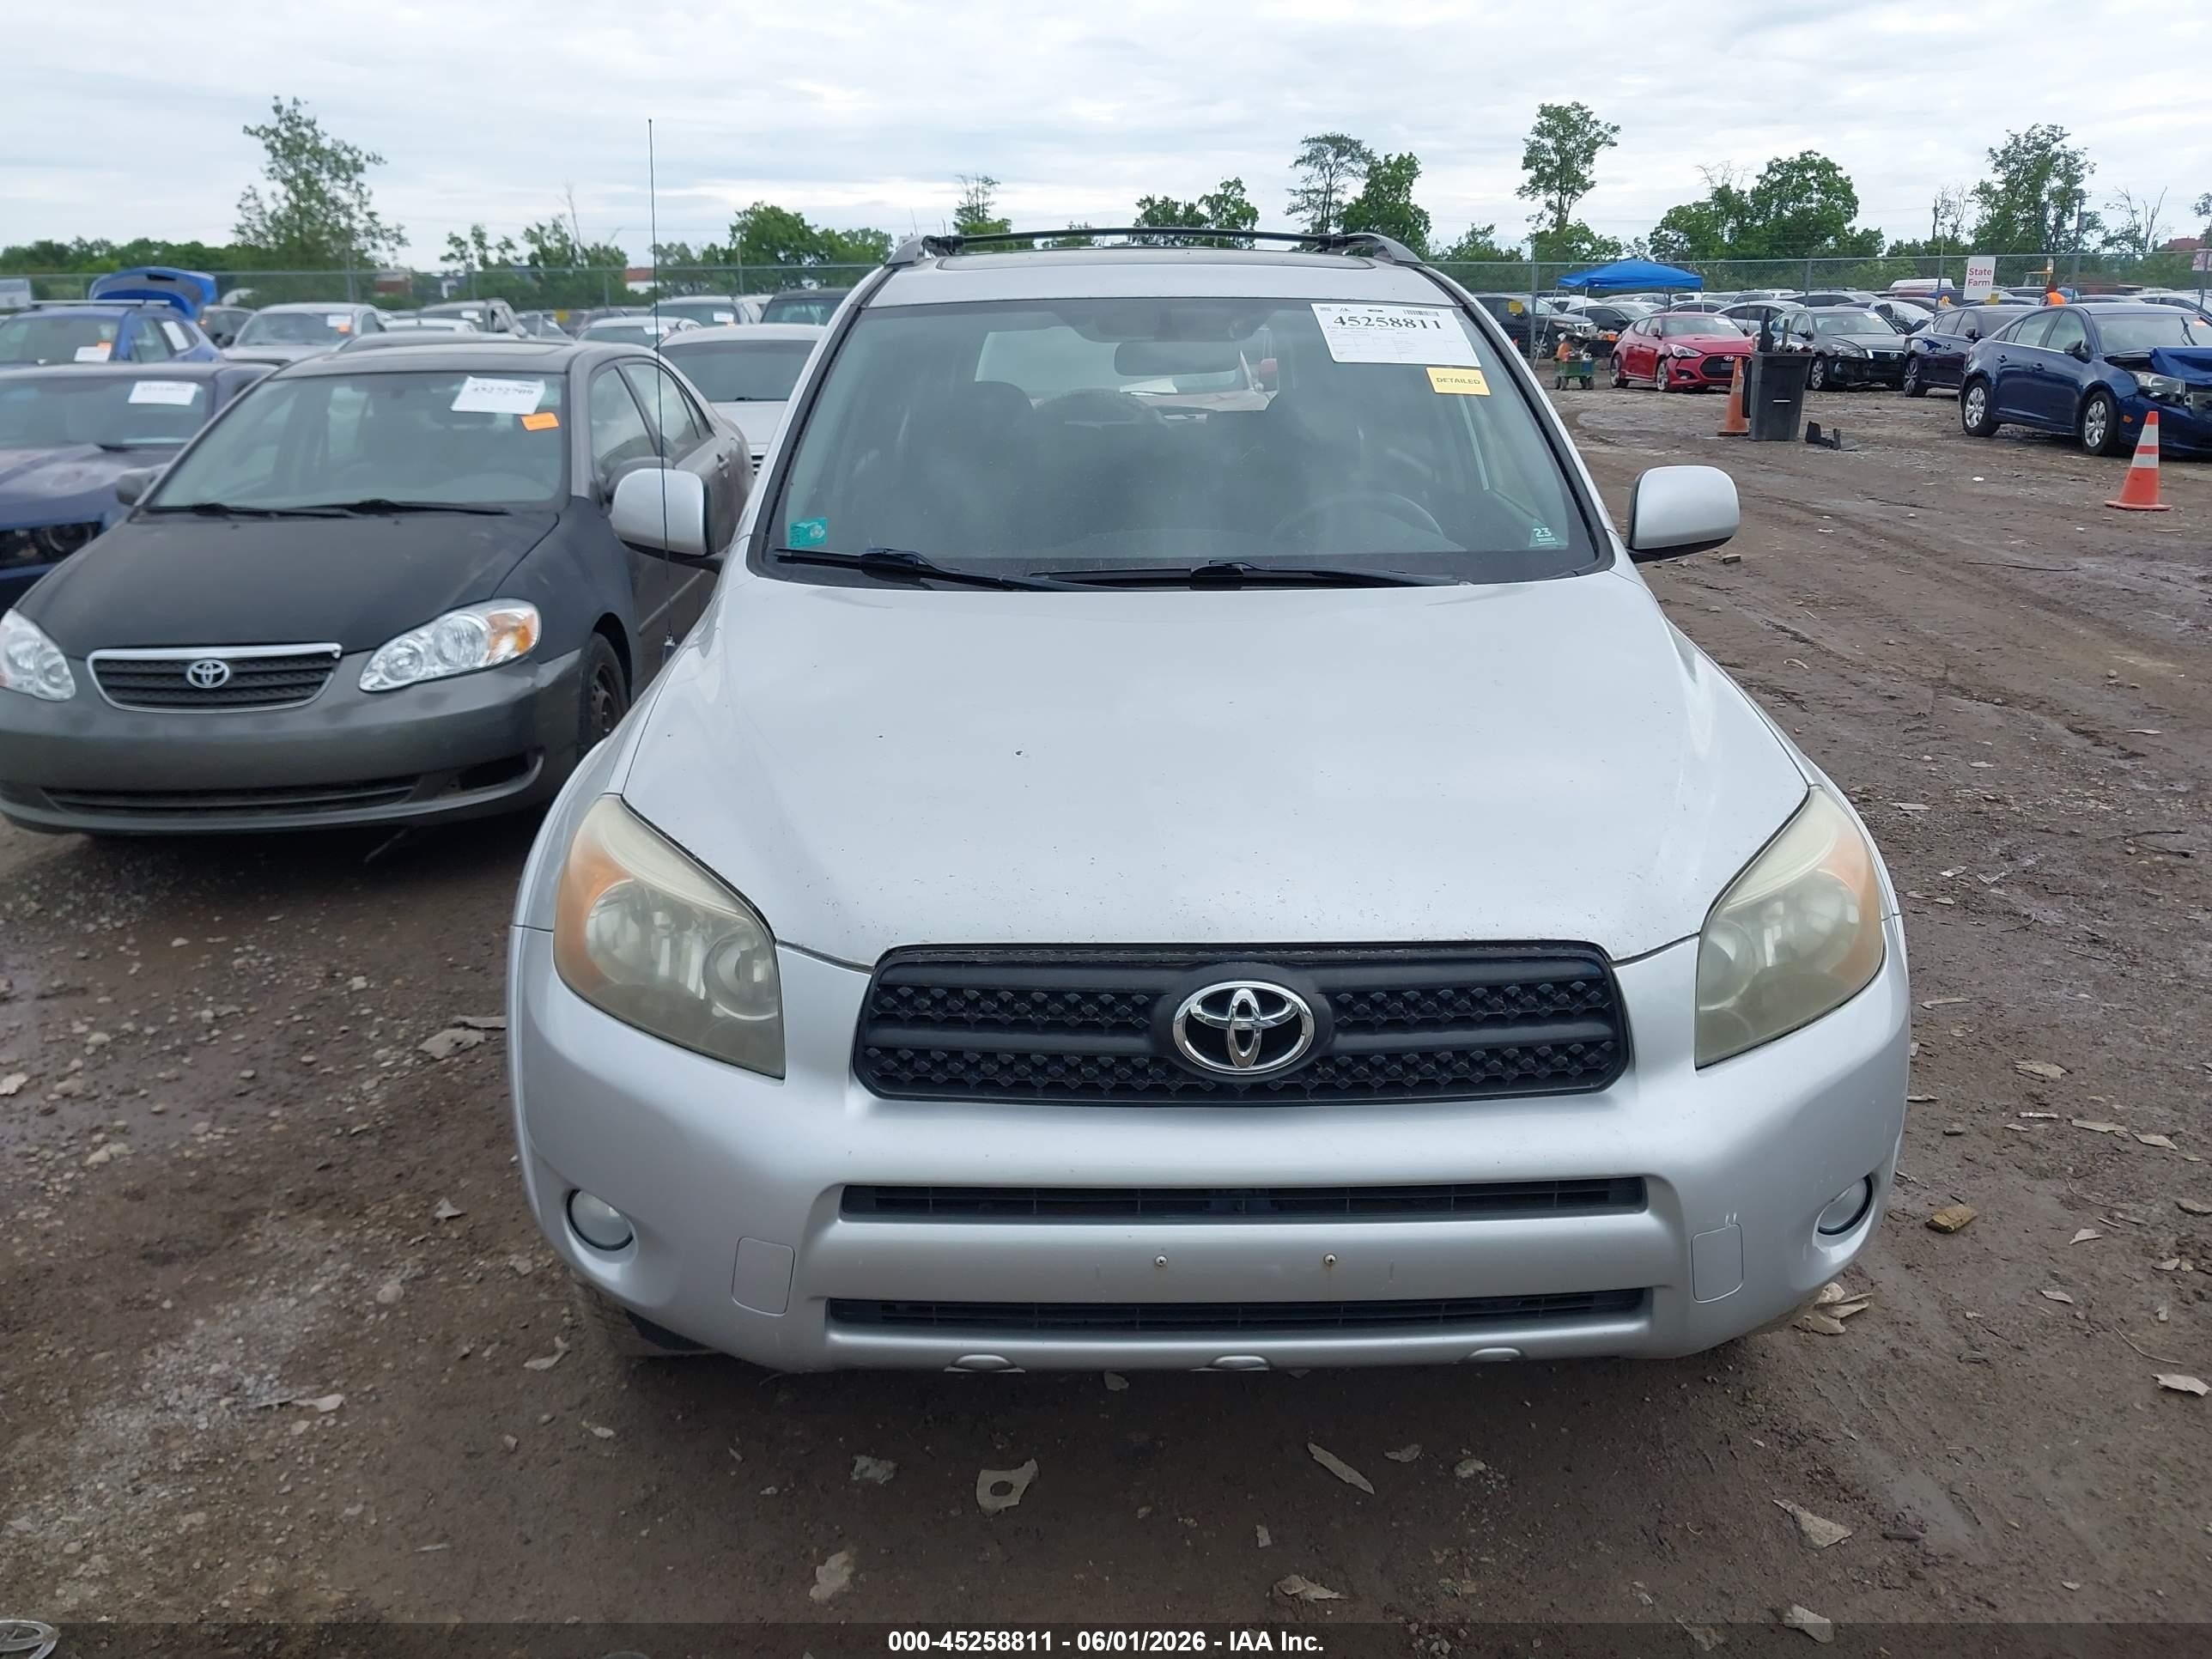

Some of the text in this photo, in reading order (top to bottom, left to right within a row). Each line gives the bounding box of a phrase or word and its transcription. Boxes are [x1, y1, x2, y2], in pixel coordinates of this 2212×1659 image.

[1968, 267, 1992, 276] State
[1967, 278, 1990, 287] Farm
[1333, 315, 1443, 330] 45258811
[1436, 376, 1481, 386] DETAILED
[1533, 527, 1552, 538] 23
